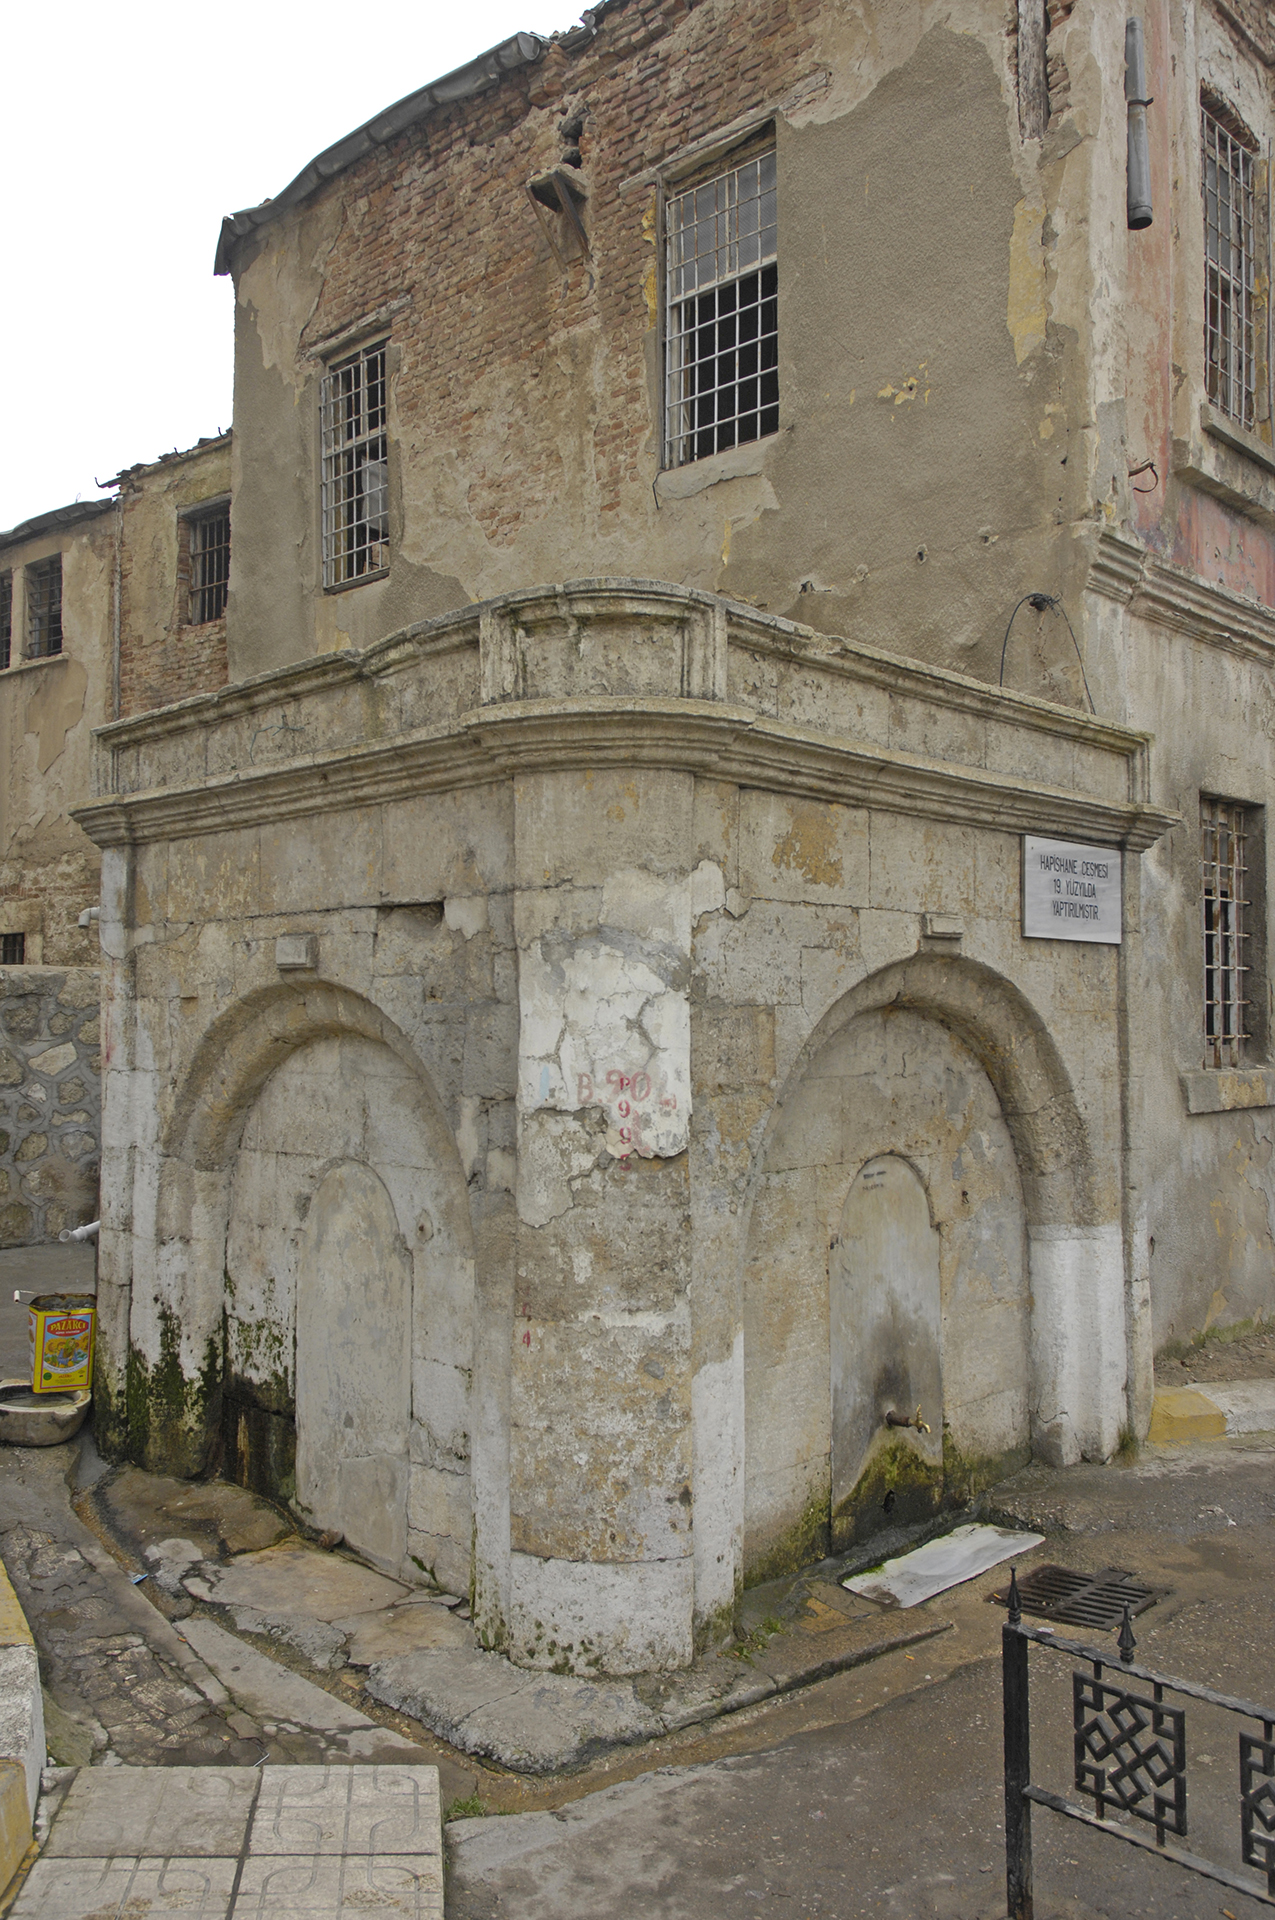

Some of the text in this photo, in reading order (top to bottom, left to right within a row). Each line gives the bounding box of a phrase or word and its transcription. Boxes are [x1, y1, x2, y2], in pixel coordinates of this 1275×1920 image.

[1040, 854, 1109, 879] HAPİSHANE ÇEŞMESİ
[1053, 878, 1097, 898] 19. YÜZYILDA
[1052, 900, 1101, 922] YAPTIRILMIŞTIR.
[50, 1319, 86, 1331] PAZARCI
